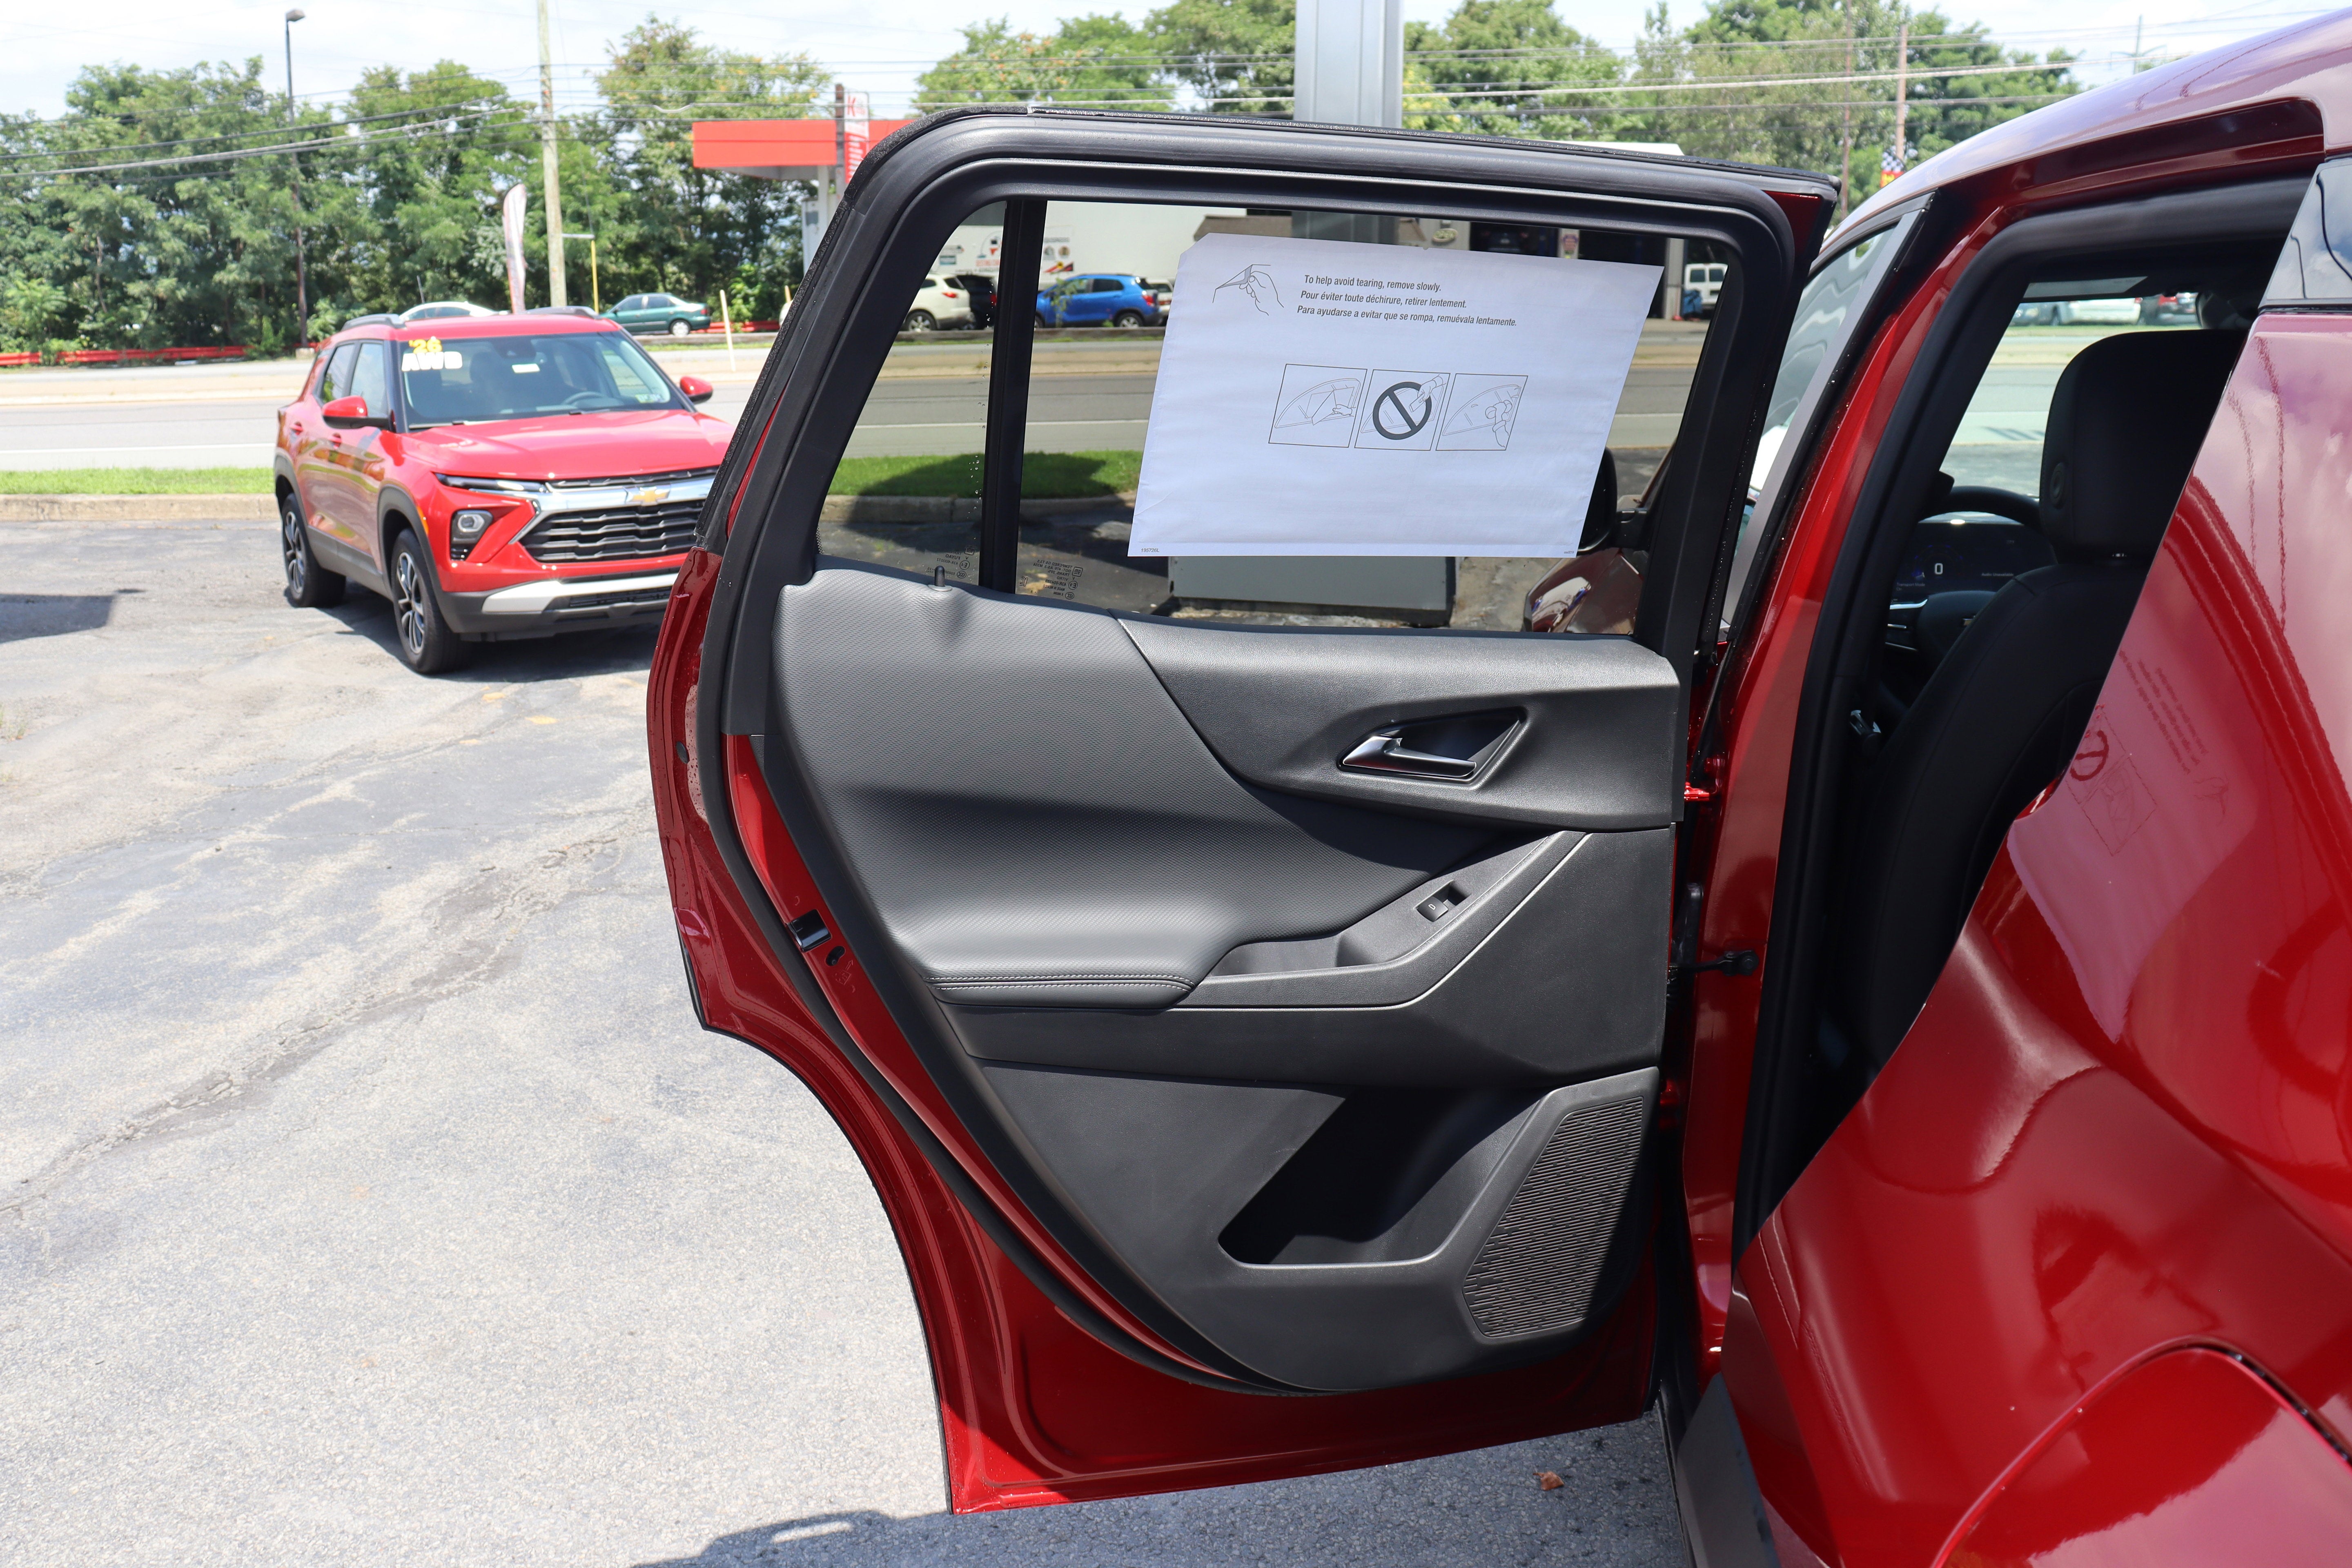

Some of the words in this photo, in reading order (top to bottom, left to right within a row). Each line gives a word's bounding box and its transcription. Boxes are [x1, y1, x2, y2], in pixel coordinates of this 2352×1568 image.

[1305, 275, 1314, 283] To
[1315, 275, 1332, 286] help
[1334, 277, 1354, 286] avoid
[1356, 278, 1384, 289] tearing,
[1387, 281, 1414, 290] remove
[1417, 282, 1441, 292] slowly.
[1301, 290, 1319, 299] Pour
[1321, 292, 1343, 301] éviter
[1345, 293, 1364, 302] toute
[1366, 294, 1403, 306] déchirure,
[1405, 297, 1428, 305] retirer
[1429, 298, 1467, 308] lentement.
[1297, 305, 1314, 314] Para
[1317, 307, 1352, 317] ayudarse
[1361, 310, 1383, 319] evitar
[1384, 313, 1397, 321] que
[1410, 314, 1435, 323] rompa,
[1437, 314, 1474, 324] remuévala
[1476, 316, 1517, 326] lentamente.
[401, 351, 463, 372] AWD
[1934, 563, 1943, 575] 0
